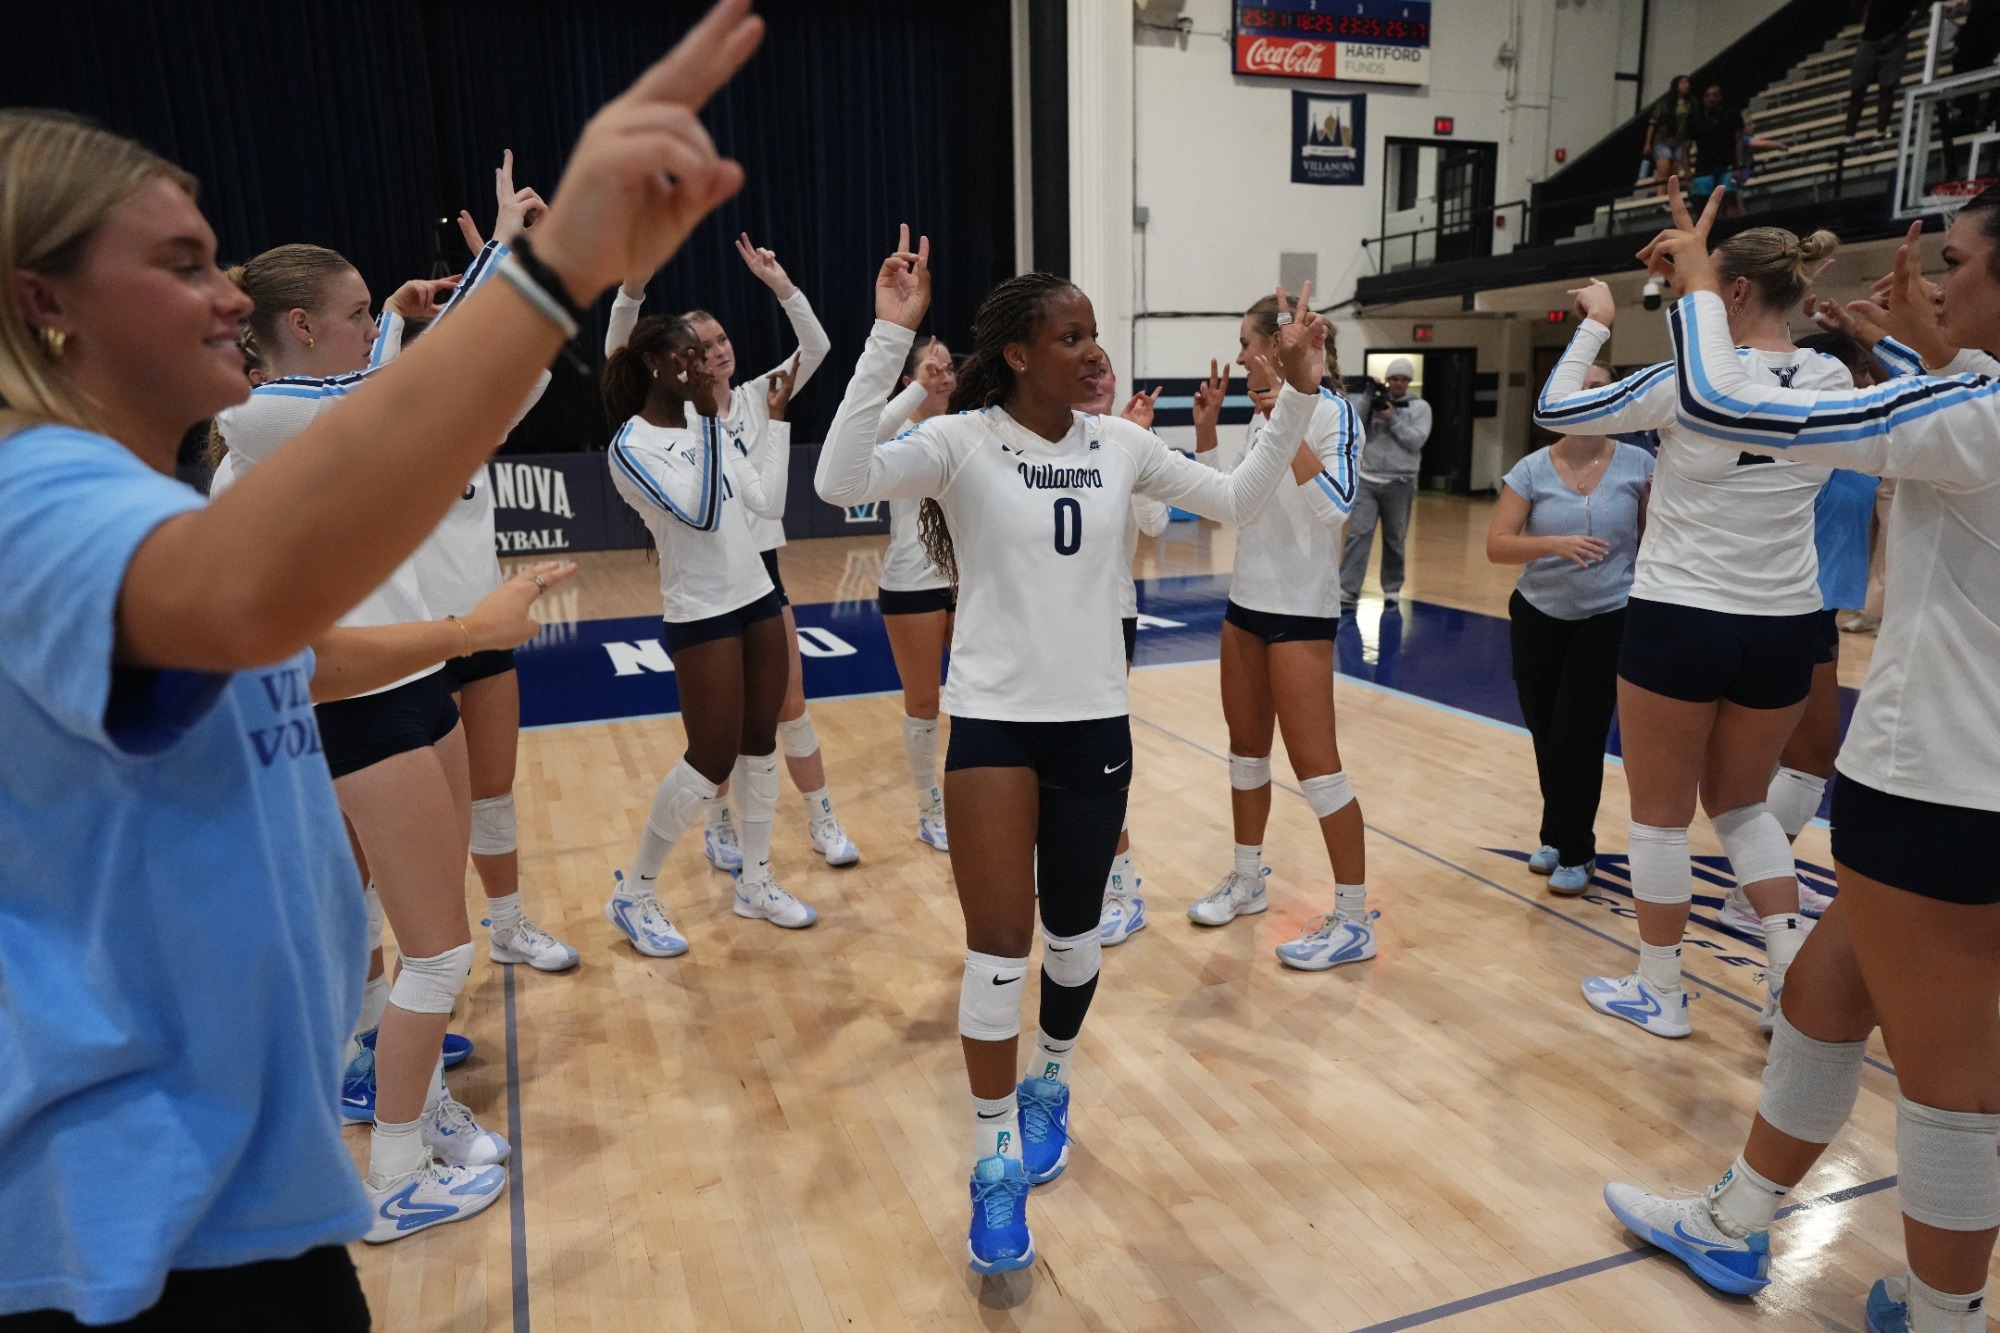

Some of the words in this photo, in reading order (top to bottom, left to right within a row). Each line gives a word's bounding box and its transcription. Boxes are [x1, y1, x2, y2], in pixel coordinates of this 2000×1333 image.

[1345, 45, 1421, 62] HARTFORD
[1345, 60, 1386, 74] FUNDS
[1018, 462, 1103, 489] Villanova
[1053, 497, 1082, 556] 0
[494, 528, 569, 551] YBALL
